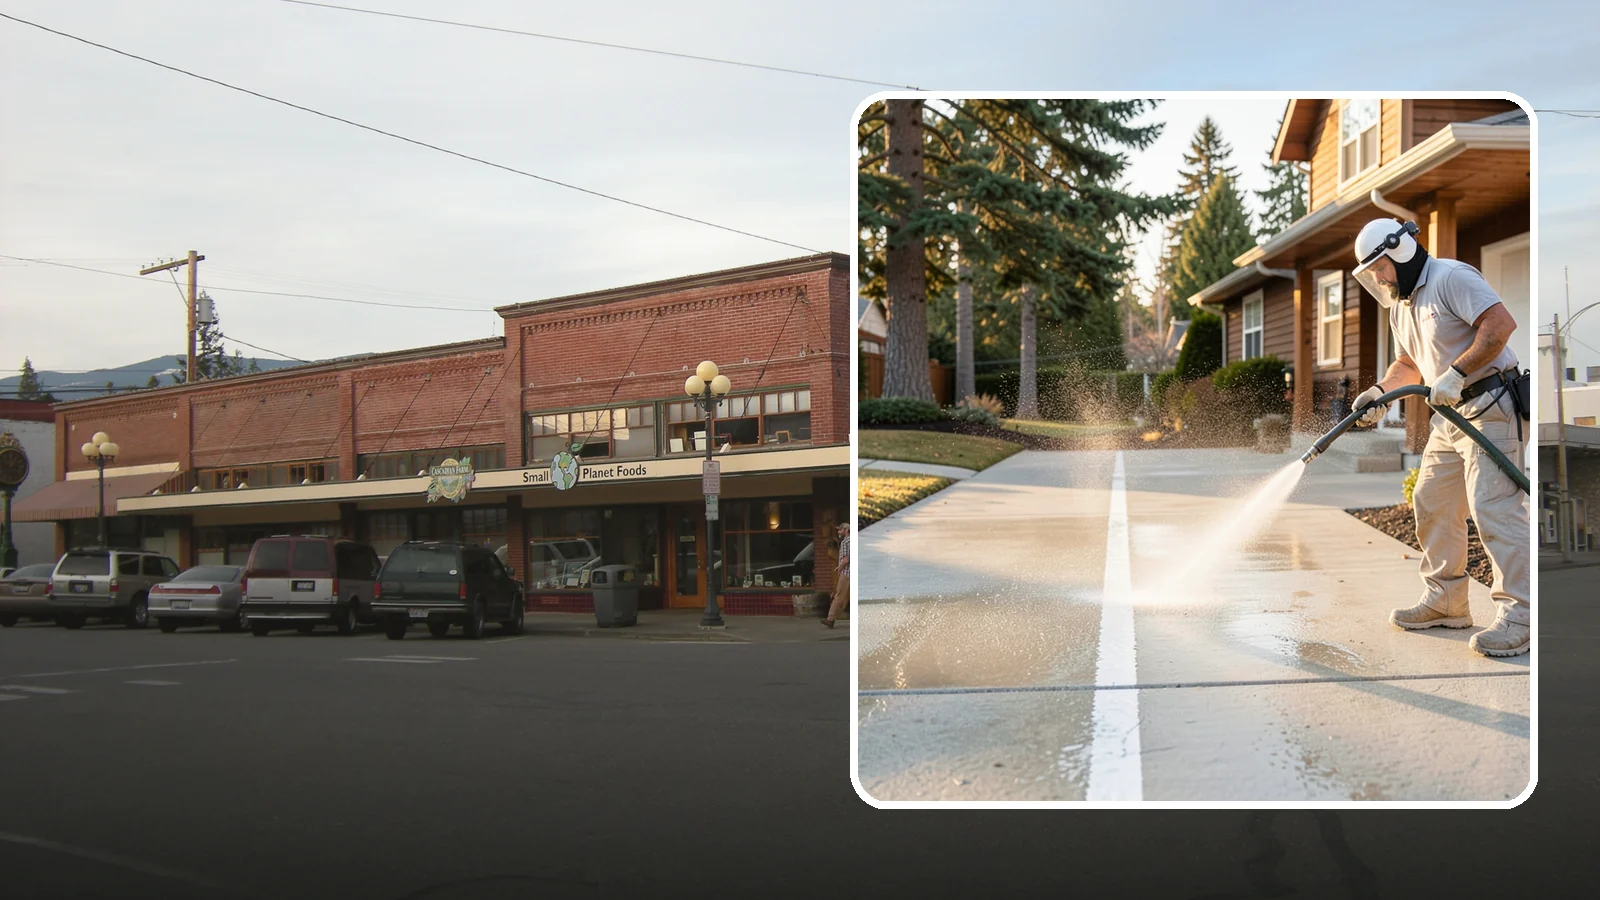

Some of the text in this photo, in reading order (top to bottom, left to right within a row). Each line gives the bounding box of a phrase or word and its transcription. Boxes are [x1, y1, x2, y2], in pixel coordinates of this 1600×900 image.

[523, 464, 647, 482] Small Planet Foods
